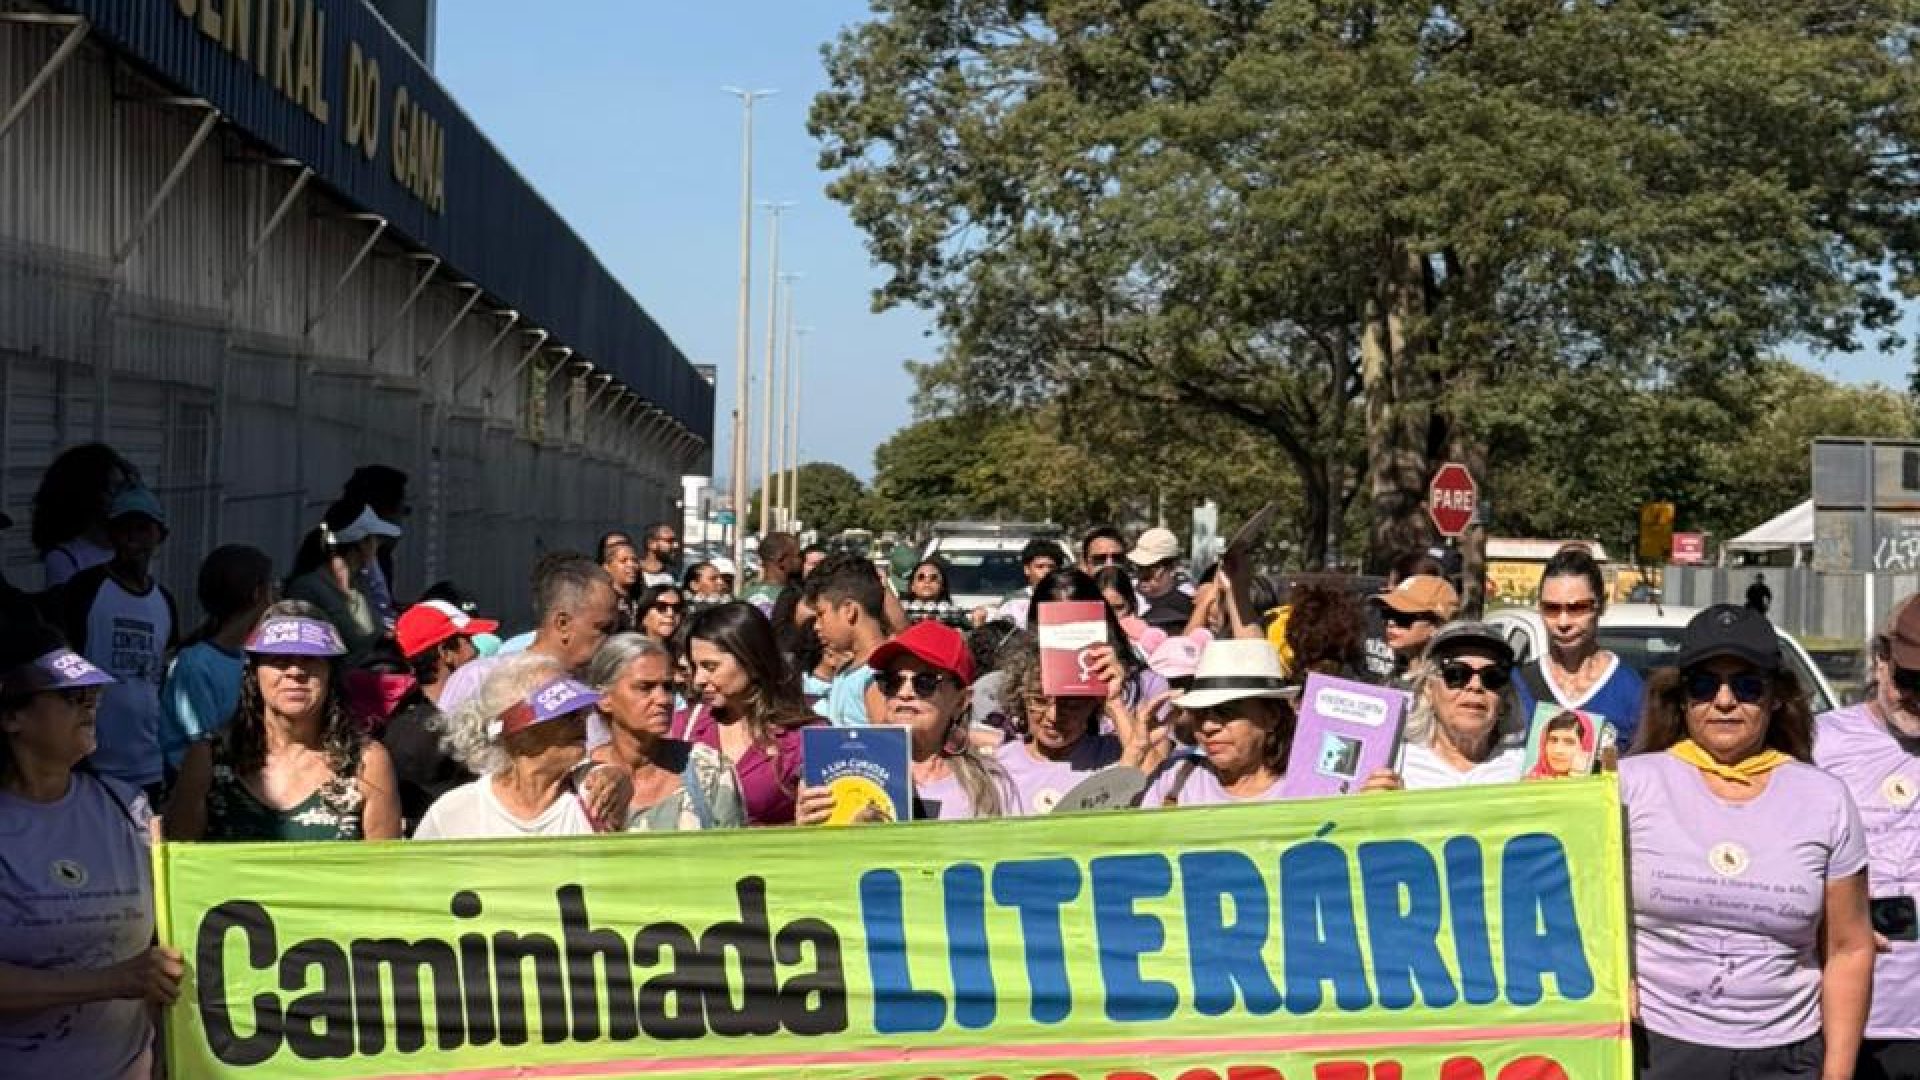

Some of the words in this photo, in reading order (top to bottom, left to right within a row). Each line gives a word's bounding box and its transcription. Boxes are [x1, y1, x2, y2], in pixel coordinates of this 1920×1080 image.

[345, 40, 381, 160] DO
[393, 86, 445, 216] GAMA
[1433, 487, 1473, 511] PARE
[196, 875, 849, 1067] Caminhada
[859, 821, 1596, 1035] LITERÁRIA
